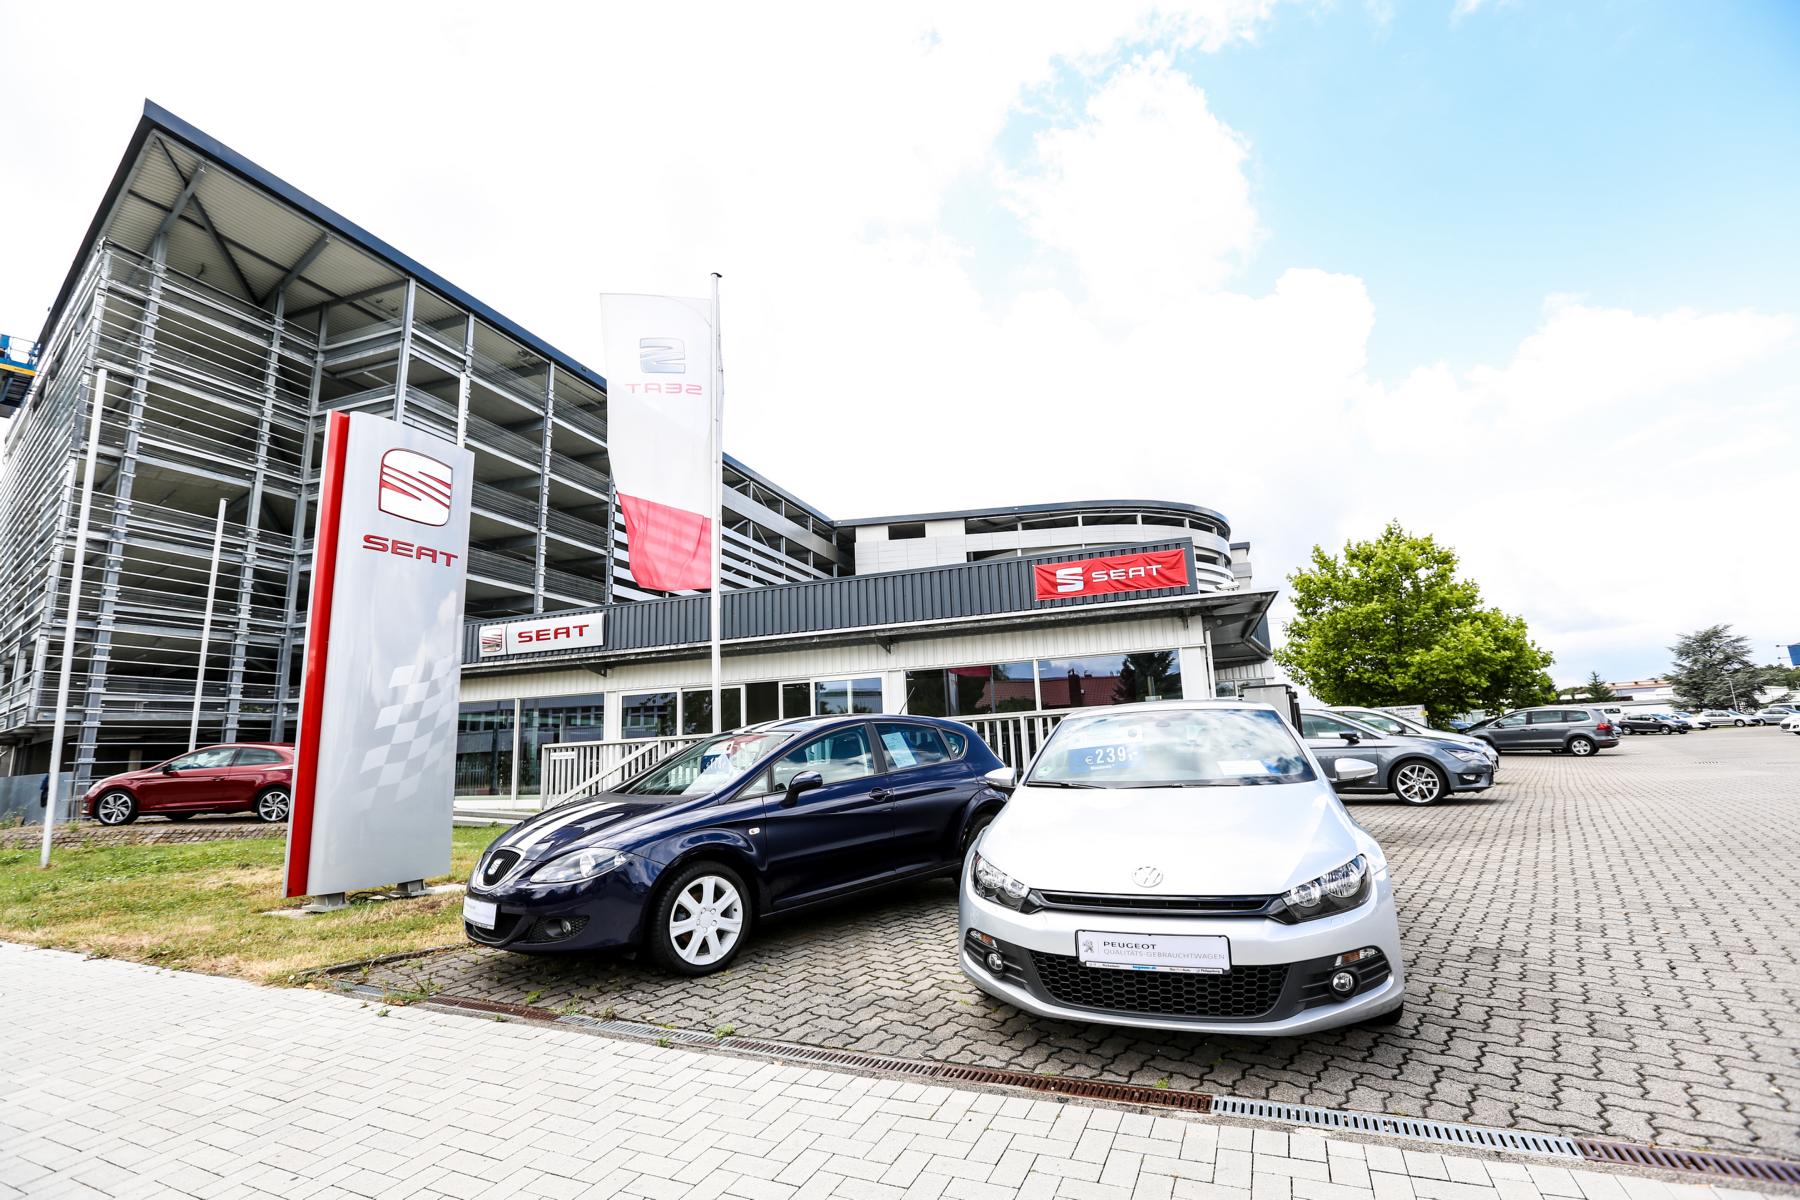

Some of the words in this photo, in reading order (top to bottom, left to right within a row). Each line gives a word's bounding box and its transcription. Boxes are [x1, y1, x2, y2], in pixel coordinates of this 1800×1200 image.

[362, 534, 459, 567] SEAT
[1091, 564, 1162, 583] SEAT
[517, 624, 590, 644] SEAT
[1103, 941, 1157, 949] PEUGEOT
